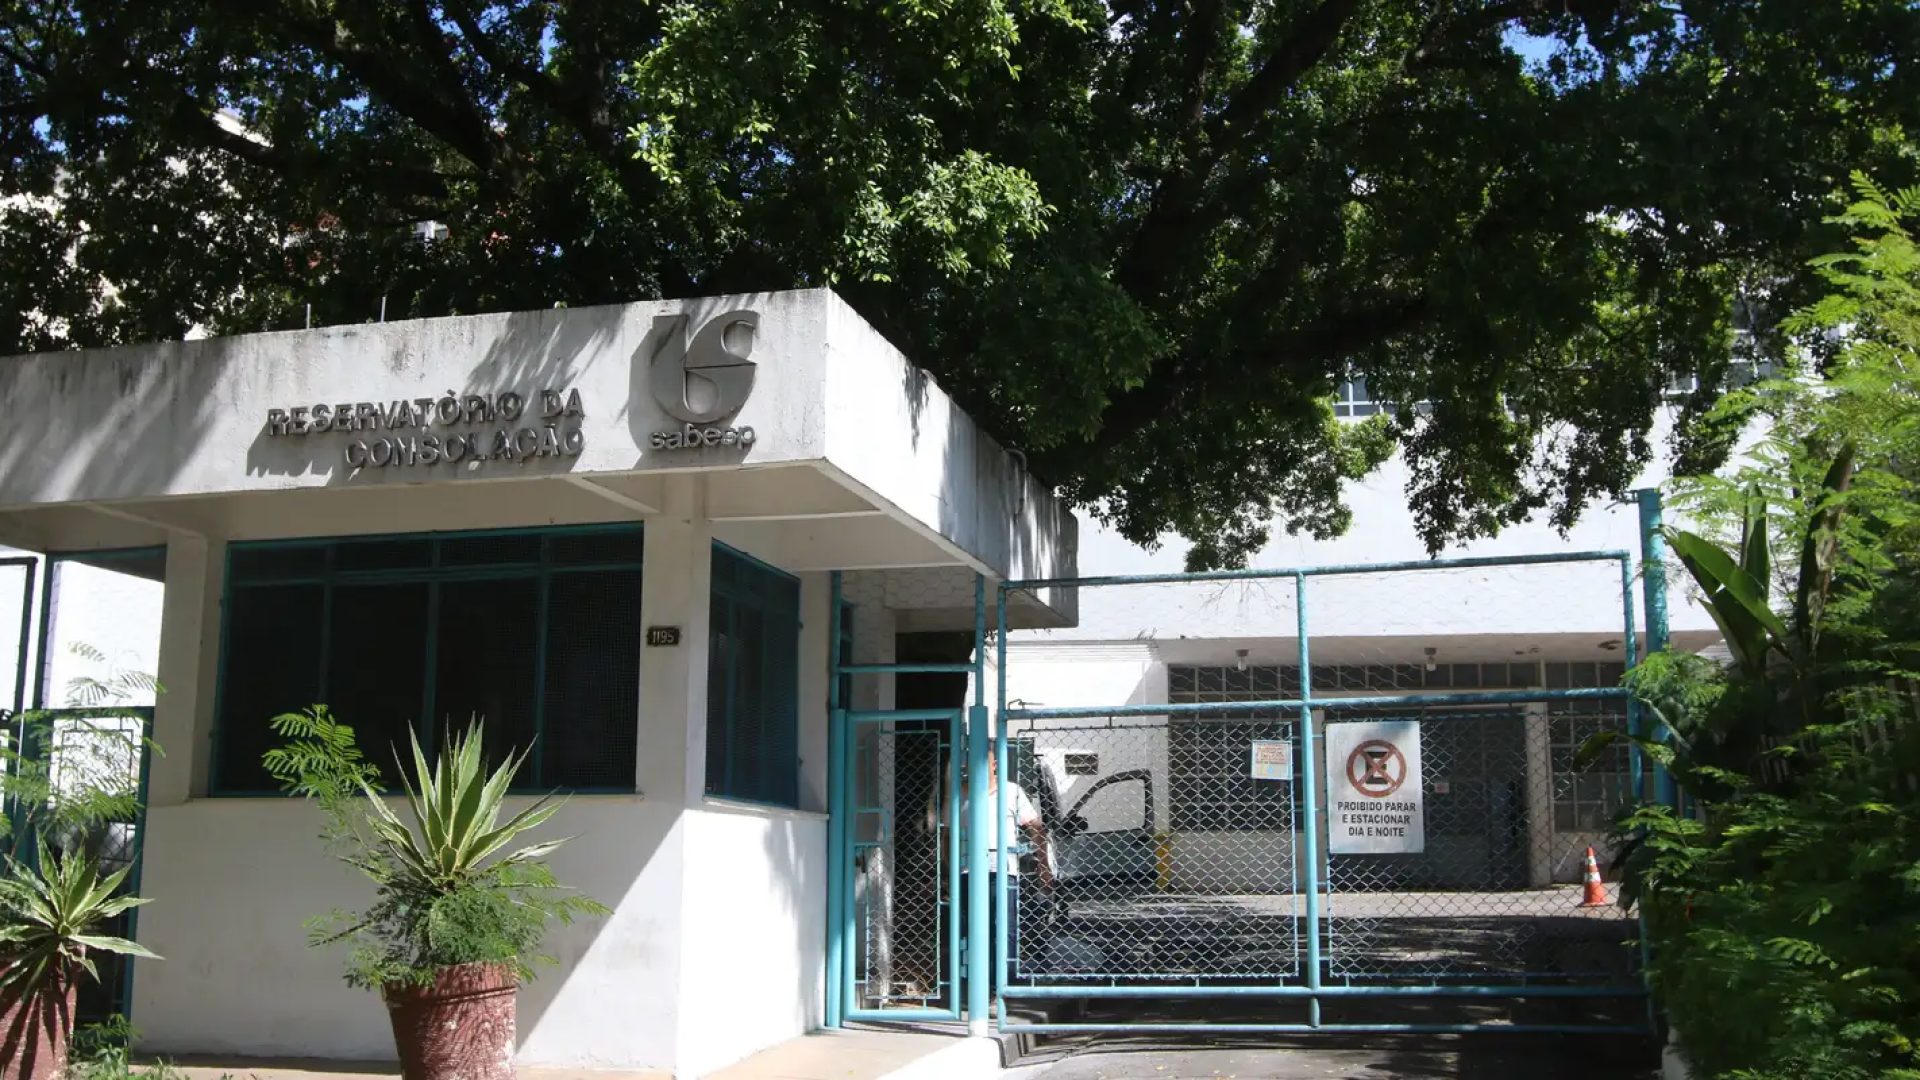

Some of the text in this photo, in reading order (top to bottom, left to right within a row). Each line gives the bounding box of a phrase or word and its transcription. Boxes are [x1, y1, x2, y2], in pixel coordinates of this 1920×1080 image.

[541, 387, 585, 418] DA
[648, 423, 756, 450] sabesp
[345, 424, 584, 468] CONSOLAÇÃO
[652, 630, 675, 644] 1195
[1337, 801, 1416, 811] PROIBIDO PARAR
[1342, 814, 1410, 824] E ESTACIONAR
[1348, 826, 1405, 837] DIA E NOITE
